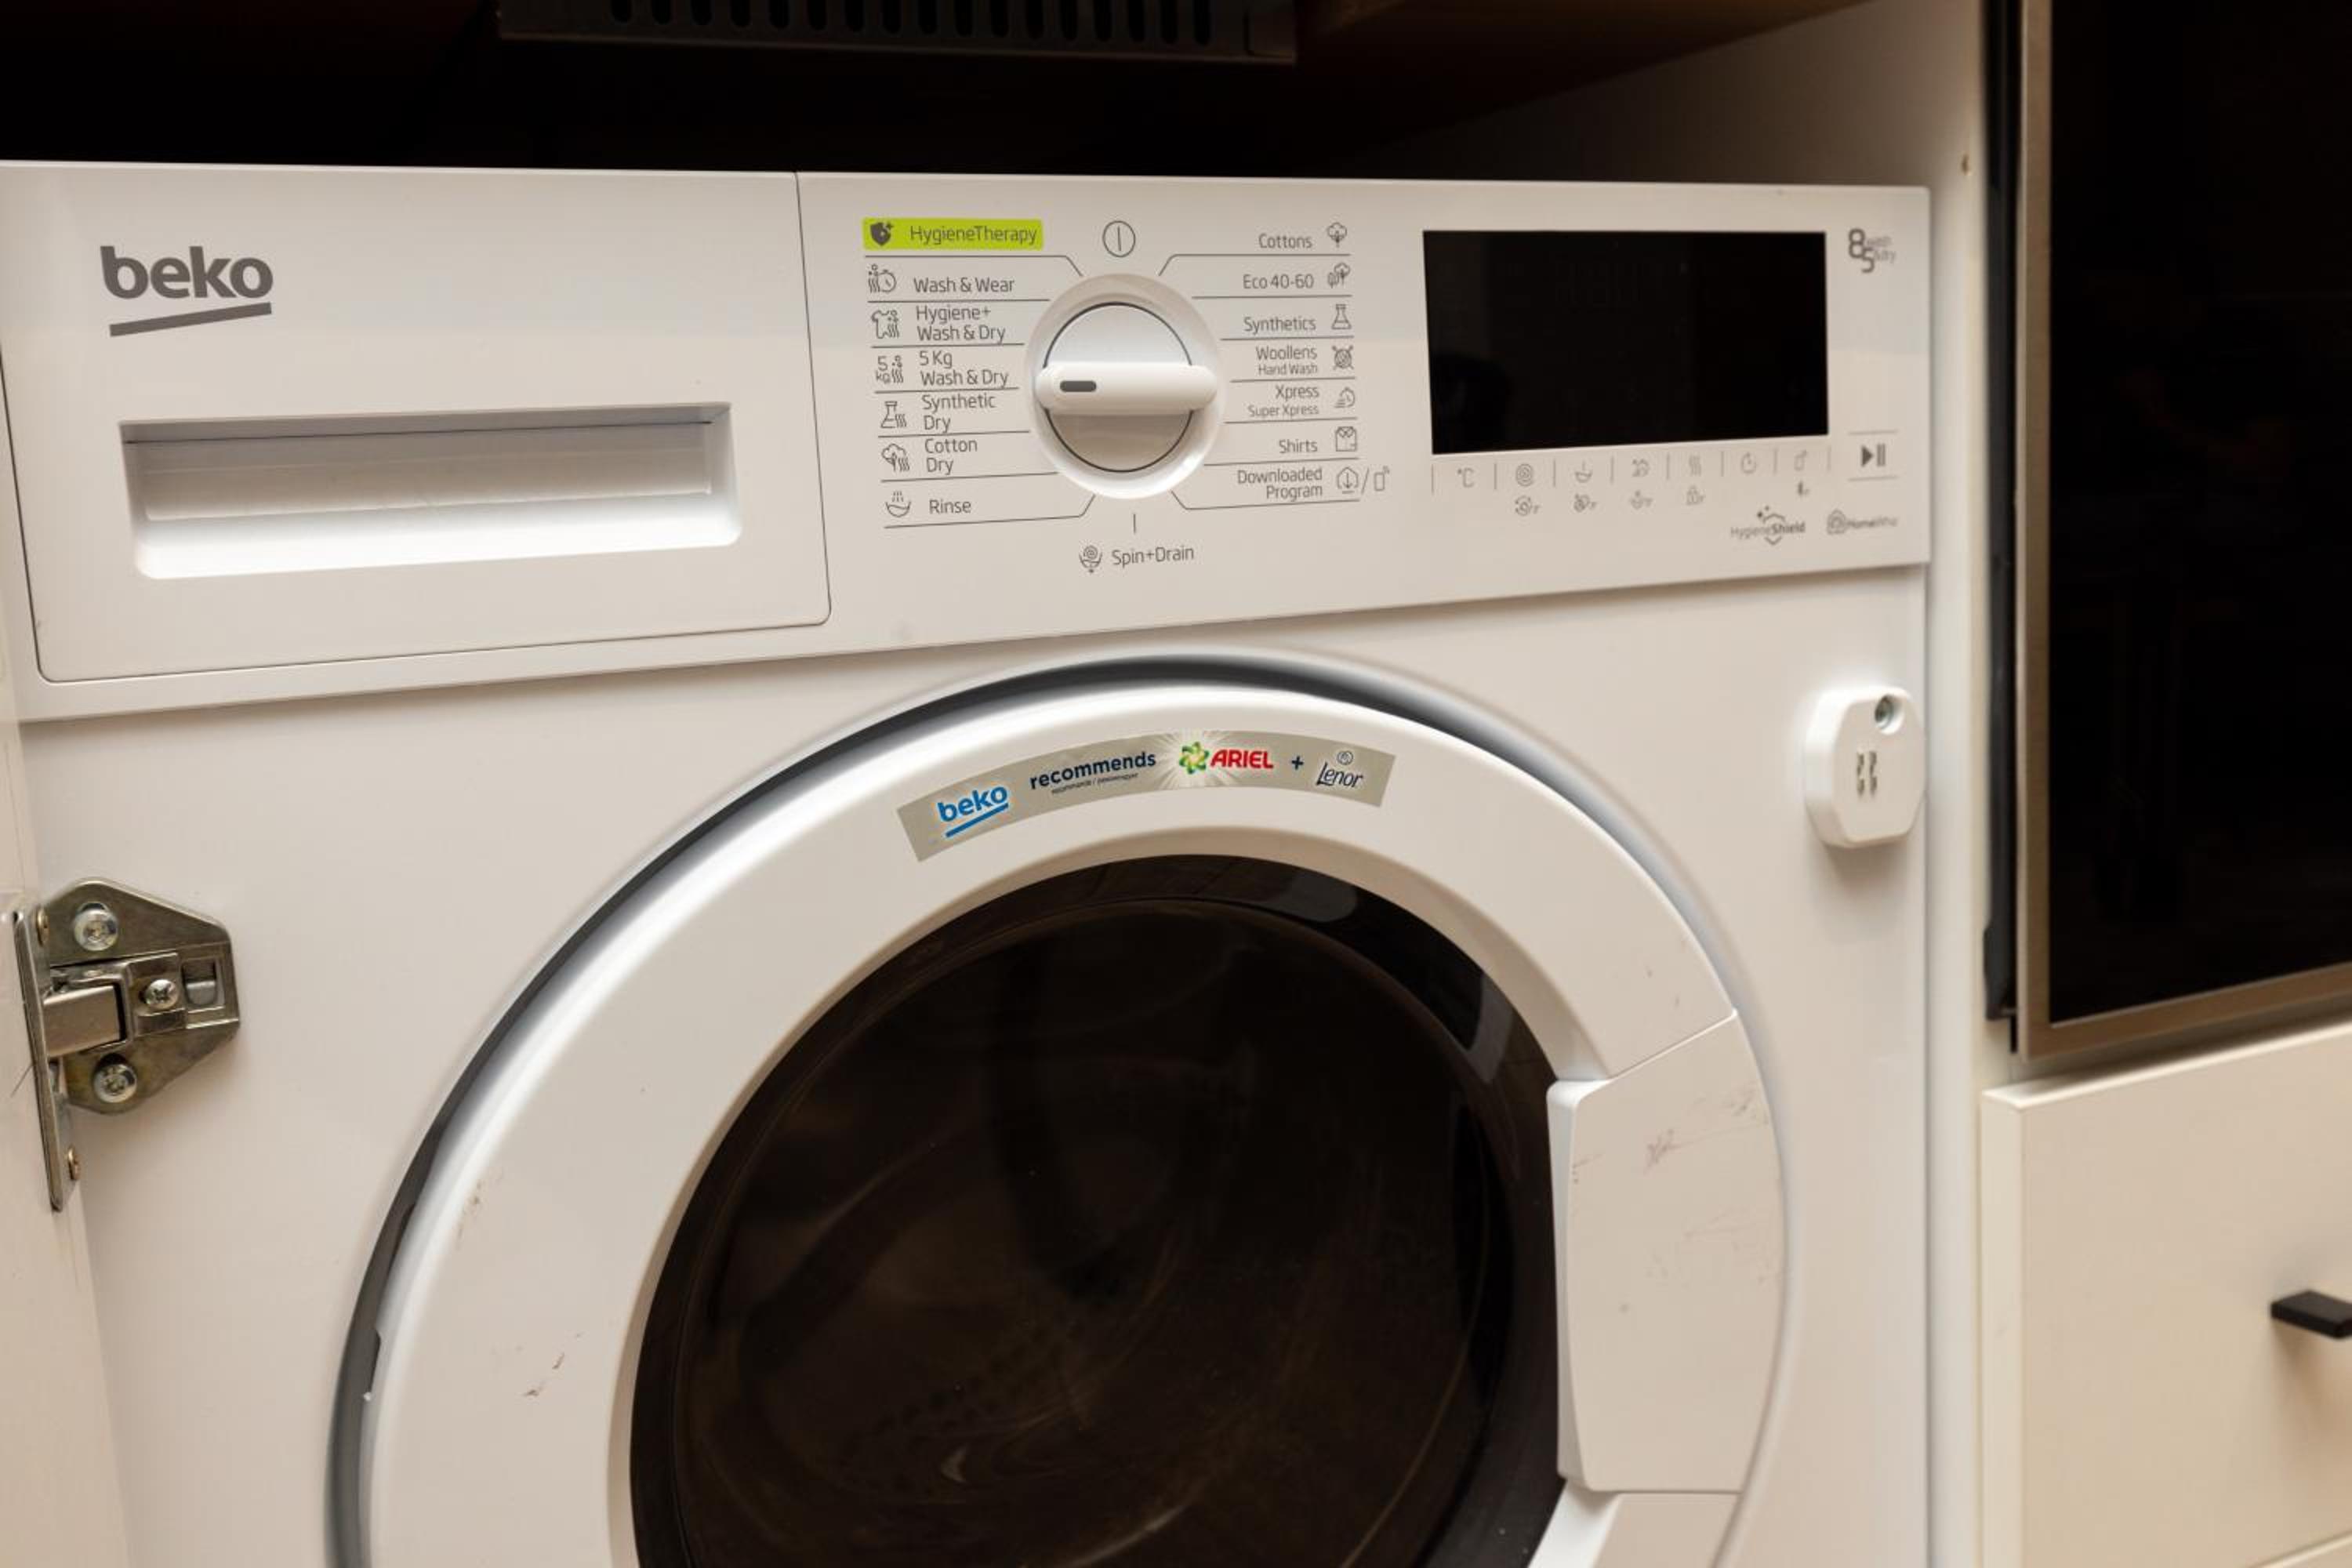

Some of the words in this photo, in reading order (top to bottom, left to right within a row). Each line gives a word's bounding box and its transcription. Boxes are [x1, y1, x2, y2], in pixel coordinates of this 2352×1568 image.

[910, 225, 1037, 245] HygieneTherapy
[1258, 234, 1313, 249] Cottons
[100, 245, 274, 299] beko
[914, 278, 956, 293] Wash
[960, 278, 972, 292] &
[976, 278, 1014, 292] Wear
[1243, 274, 1268, 289] Eco
[1270, 274, 1314, 289] 40-60
[916, 306, 991, 324] Hygiene+
[917, 327, 959, 341] Wash
[964, 325, 975, 339] &
[979, 325, 1006, 344] Dry
[1243, 316, 1316, 335] Synthetics
[919, 351, 929, 365] 5
[931, 350, 953, 368] Kg
[1256, 347, 1318, 361] Woollens
[920, 371, 963, 386] Wash
[967, 370, 978, 384] &
[982, 369, 1009, 388] Dry
[1258, 364, 1287, 376] Hand
[1275, 384, 1320, 401] Xpress
[921, 394, 996, 413] Synthetic
[1247, 405, 1279, 419] Super
[1282, 404, 1319, 417] Xpress
[924, 415, 951, 433] Dry
[924, 438, 978, 453] Cotton
[1279, 439, 1318, 454] Shirts
[927, 457, 954, 474] Dry
[1237, 467, 1323, 485] Downloaded
[1266, 485, 1323, 502] Program
[929, 499, 972, 514] Rinse
[1112, 545, 1194, 568] Spin+Drain
[1029, 751, 1156, 789] recommends
[1210, 750, 1274, 769] ARIEL
[1316, 761, 1363, 788] Lenor
[938, 786, 1008, 823] beko
